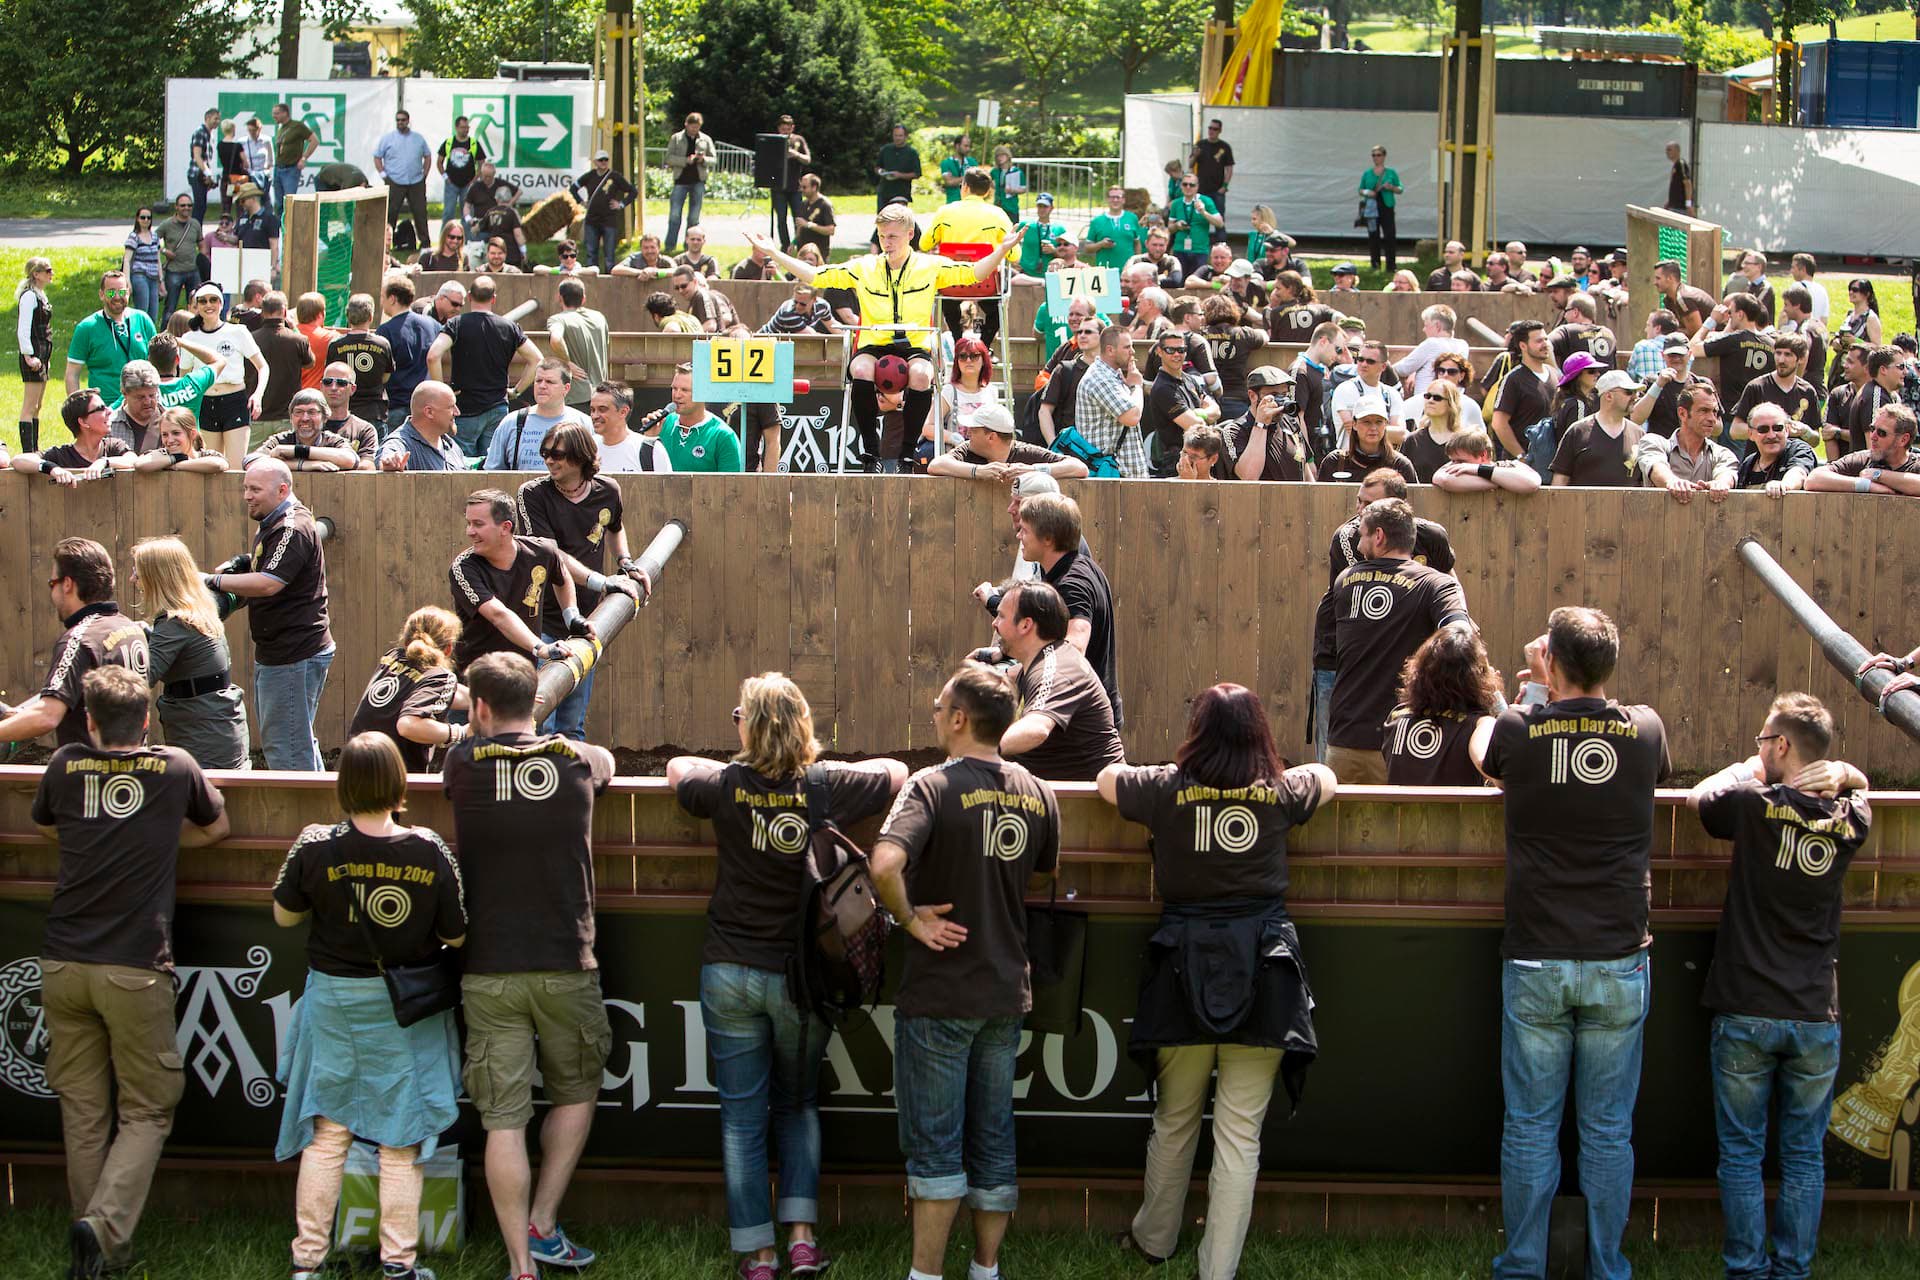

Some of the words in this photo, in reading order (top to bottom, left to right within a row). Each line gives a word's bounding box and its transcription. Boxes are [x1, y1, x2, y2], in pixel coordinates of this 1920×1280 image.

[500, 174, 573, 188] USGANG
[1066, 277, 1076, 295] 7
[1091, 275, 1102, 293] 4
[1289, 310, 1313, 329] 10
[1588, 338, 1610, 357] 10
[1744, 348, 1768, 370] 10
[347, 352, 374, 373] 10
[717, 349, 732, 377] 5
[749, 349, 764, 377] 2
[158, 384, 197, 407] NDRE
[1342, 571, 1373, 589] Ardbeg
[1374, 570, 1394, 584] Day
[1350, 585, 1394, 620] 10
[1392, 718, 1443, 759] 10
[1529, 719, 1578, 739] Ardbeg
[1580, 717, 1605, 734] Day
[66, 758, 110, 774] Ardbeg
[111, 759, 135, 773] Day
[136, 757, 167, 774] 2014
[1551, 737, 1618, 785] 10
[496, 757, 559, 801] 10
[84, 774, 144, 819] 10
[768, 793, 793, 807] Day
[1249, 785, 1278, 806] 2014
[752, 809, 809, 854] 10
[983, 810, 1028, 861] 10
[1195, 805, 1259, 853] 10
[1775, 824, 1837, 877] 10
[376, 863, 402, 880] Day
[403, 865, 435, 886] 2014
[1846, 1096, 1890, 1128] ARDBEG
[1847, 1113, 1873, 1133] DAY
[1834, 1120, 1870, 1148] 2014
